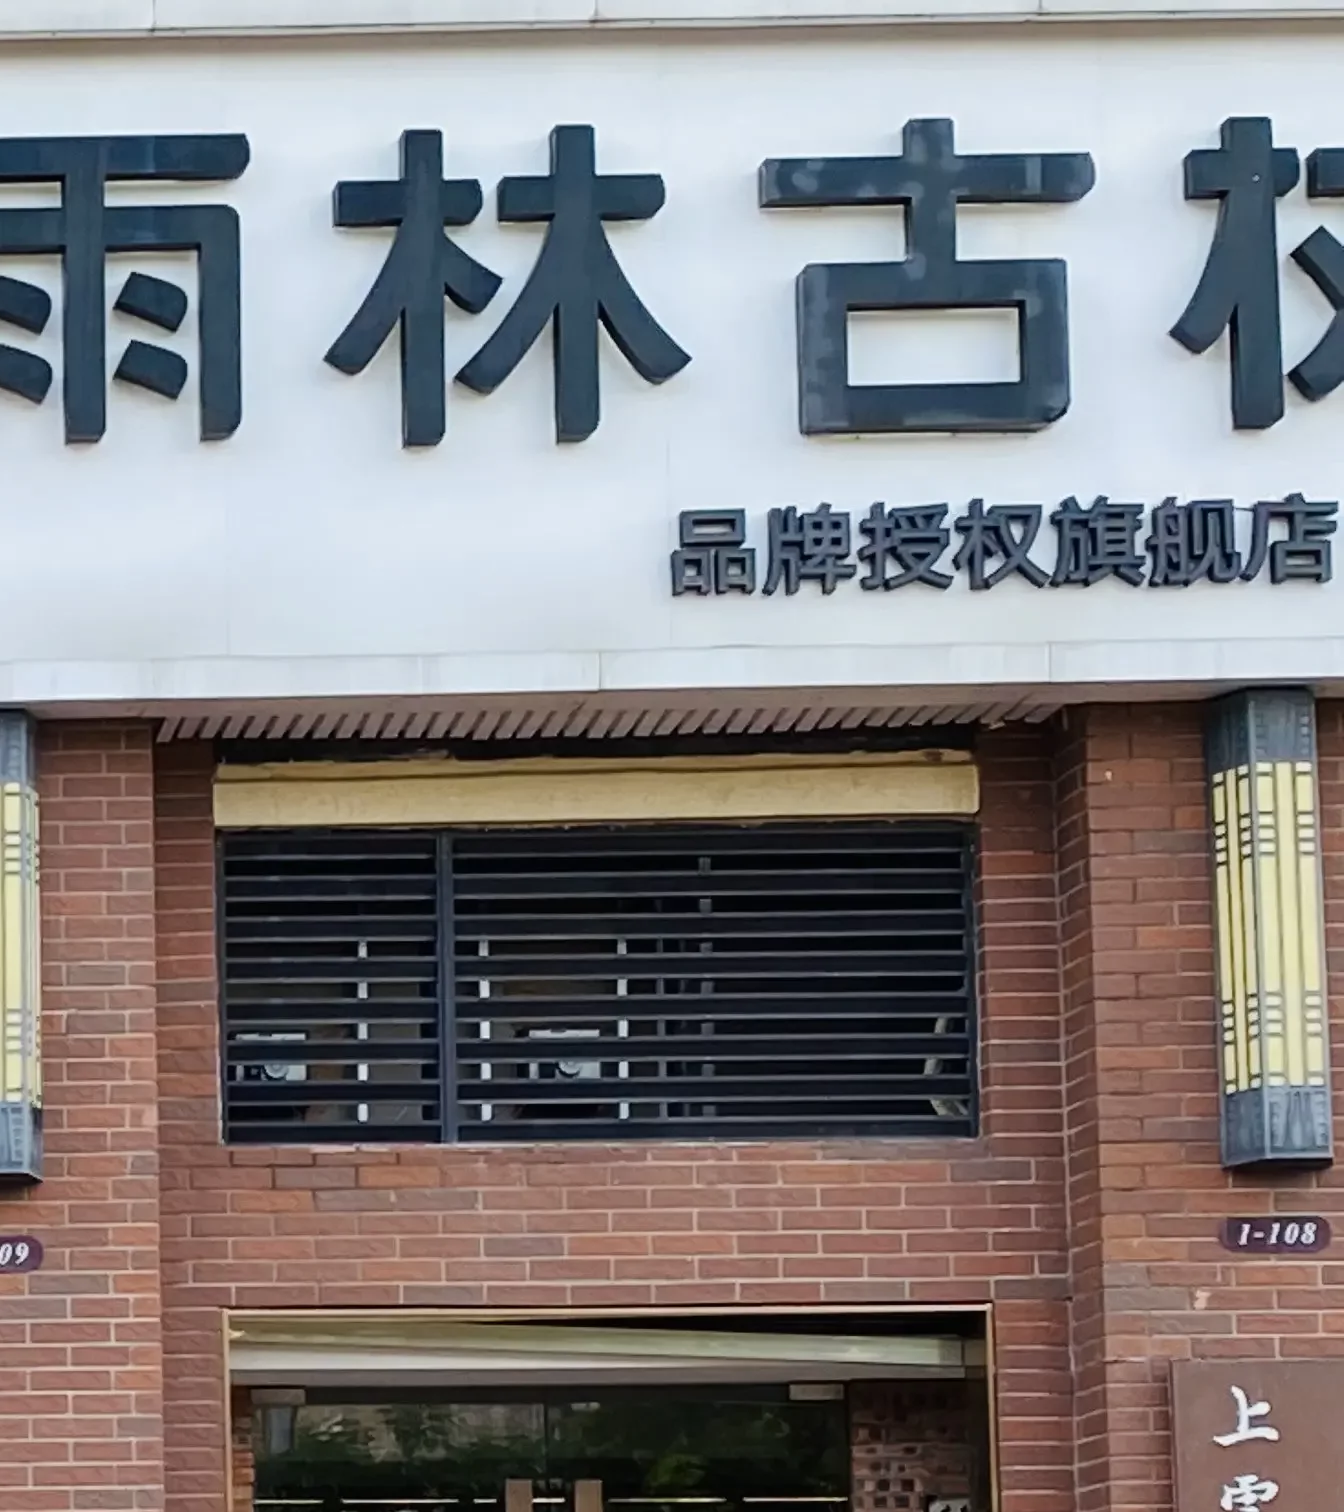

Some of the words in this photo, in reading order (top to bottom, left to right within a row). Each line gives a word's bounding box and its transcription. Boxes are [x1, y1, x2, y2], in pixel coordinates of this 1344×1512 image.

[670, 494, 1339, 597] 品牌授权旗舰店
[1238, 1222, 1317, 1245] 1-108
